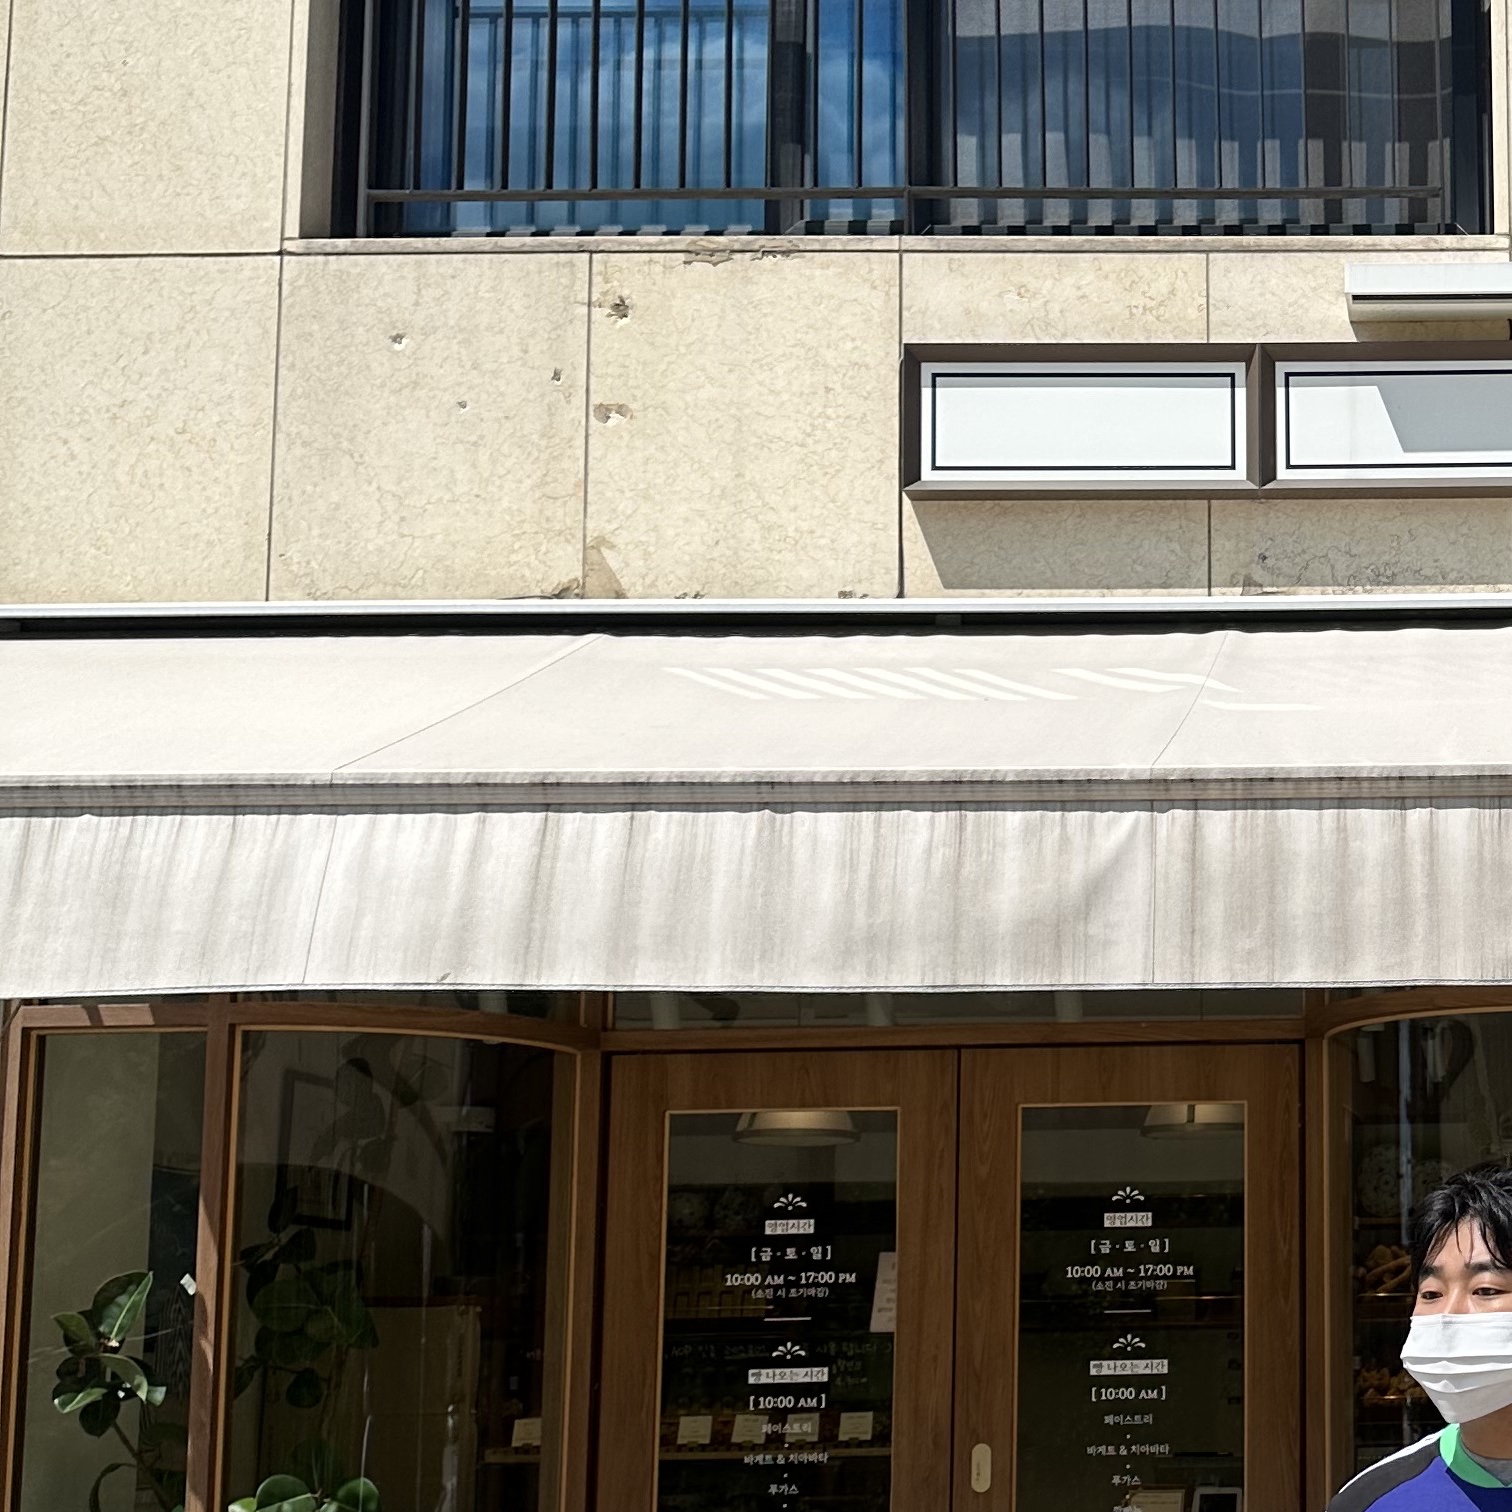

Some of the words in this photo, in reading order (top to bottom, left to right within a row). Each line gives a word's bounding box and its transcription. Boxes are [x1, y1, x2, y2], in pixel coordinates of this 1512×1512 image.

[1106, 1214, 1150, 1227] 영업시간
[767, 1221, 812, 1233] 영업시간
[1066, 1266, 1100, 1278] 10:00
[1104, 1267, 1123, 1277] AM
[1139, 1264, 1173, 1276] 17:00
[1176, 1265, 1194, 1276] PM
[725, 1273, 761, 1286] 10:00
[765, 1274, 784, 1285] AM
[800, 1271, 835, 1284] 17:00
[838, 1272, 856, 1283] PM
[1116, 1280, 1125, 1290] 시
[776, 1288, 786, 1298] 시
[1092, 1362, 1104, 1374] 빵
[1107, 1361, 1139, 1374] 나오는
[1143, 1360, 1166, 1373] 시간
[751, 1371, 762, 1382] 빵
[765, 1370, 799, 1382] 나오는
[803, 1368, 826, 1381] 시간
[1100, 1388, 1135, 1400] 10:00
[758, 1396, 794, 1408] 10:00
[1104, 1413, 1153, 1425] 페이스트리
[761, 1423, 812, 1434] 페이스트리
[1087, 1445, 1117, 1456] 바게트
[1119, 1446, 1128, 1455] &
[1130, 1444, 1170, 1455] 치아바타
